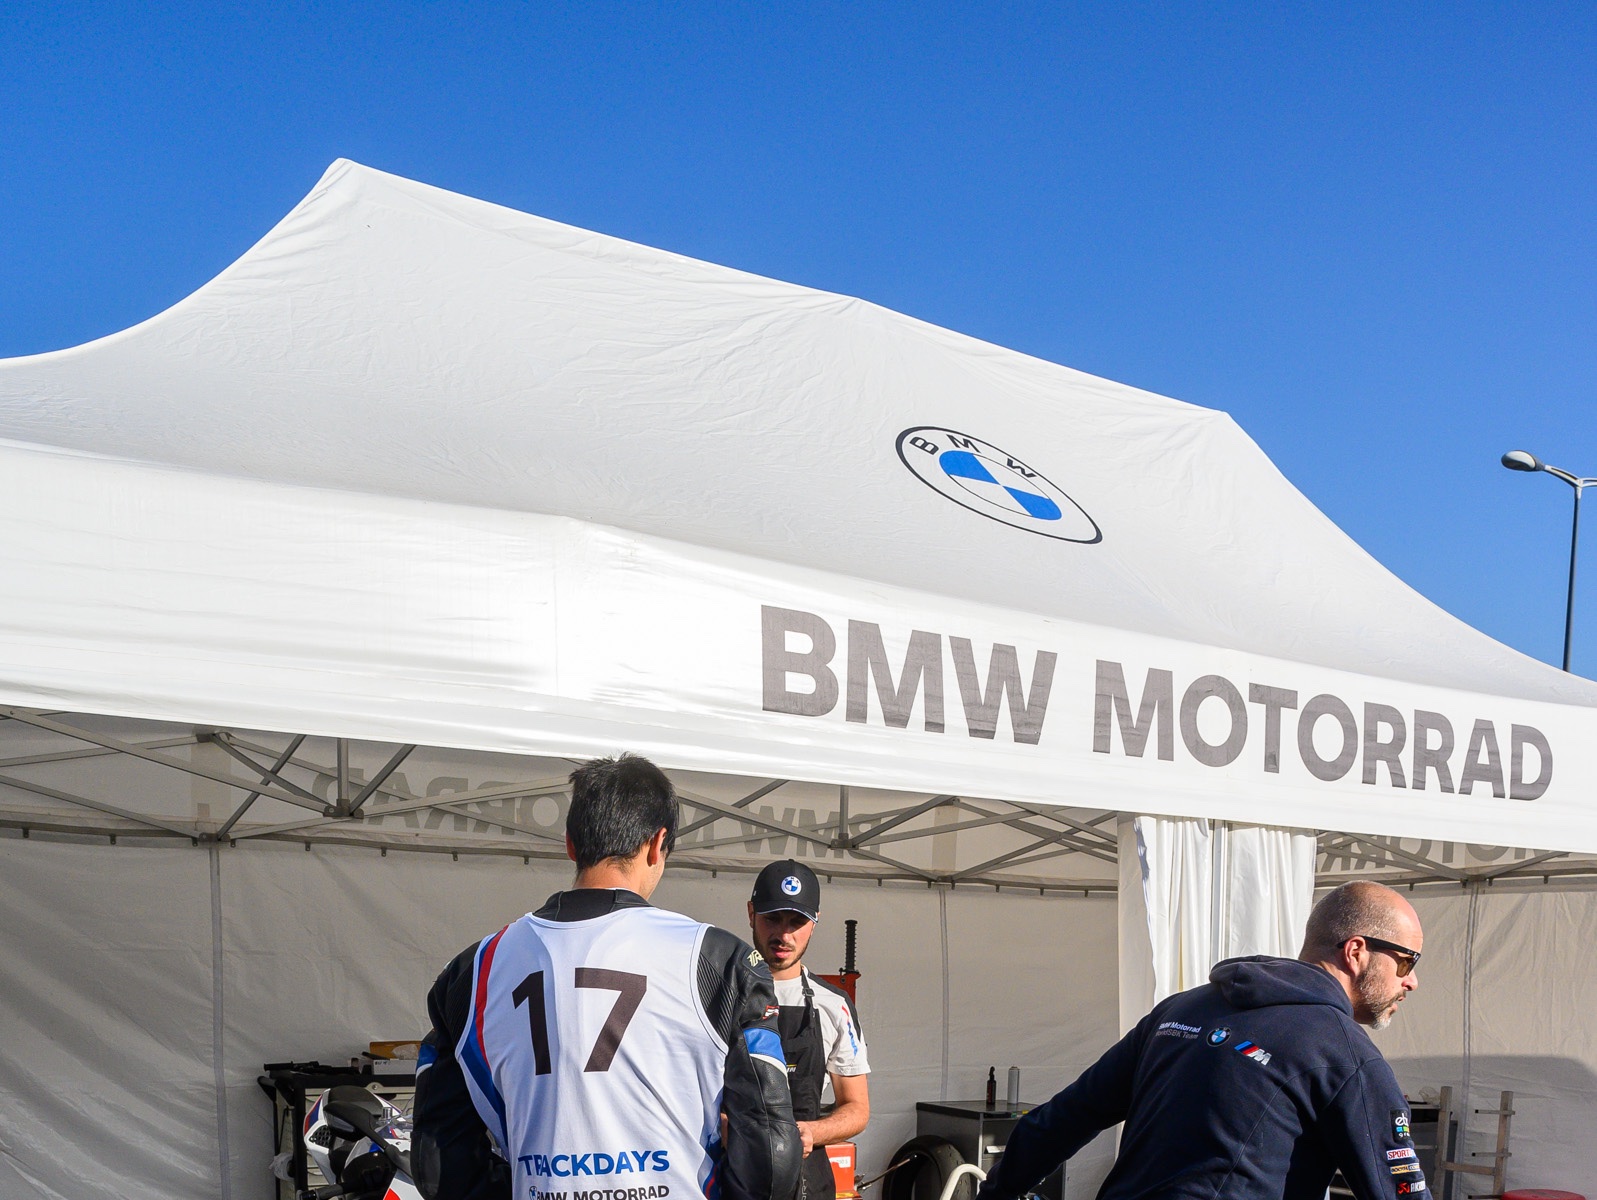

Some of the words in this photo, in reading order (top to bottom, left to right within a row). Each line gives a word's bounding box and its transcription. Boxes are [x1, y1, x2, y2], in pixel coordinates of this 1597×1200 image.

[909, 433, 1038, 480] BMW
[761, 604, 1058, 746] BMW
[1092, 660, 1554, 801] MOTORRAD
[511, 967, 648, 1076] 17
[1170, 1021, 1202, 1034] Motorrad
